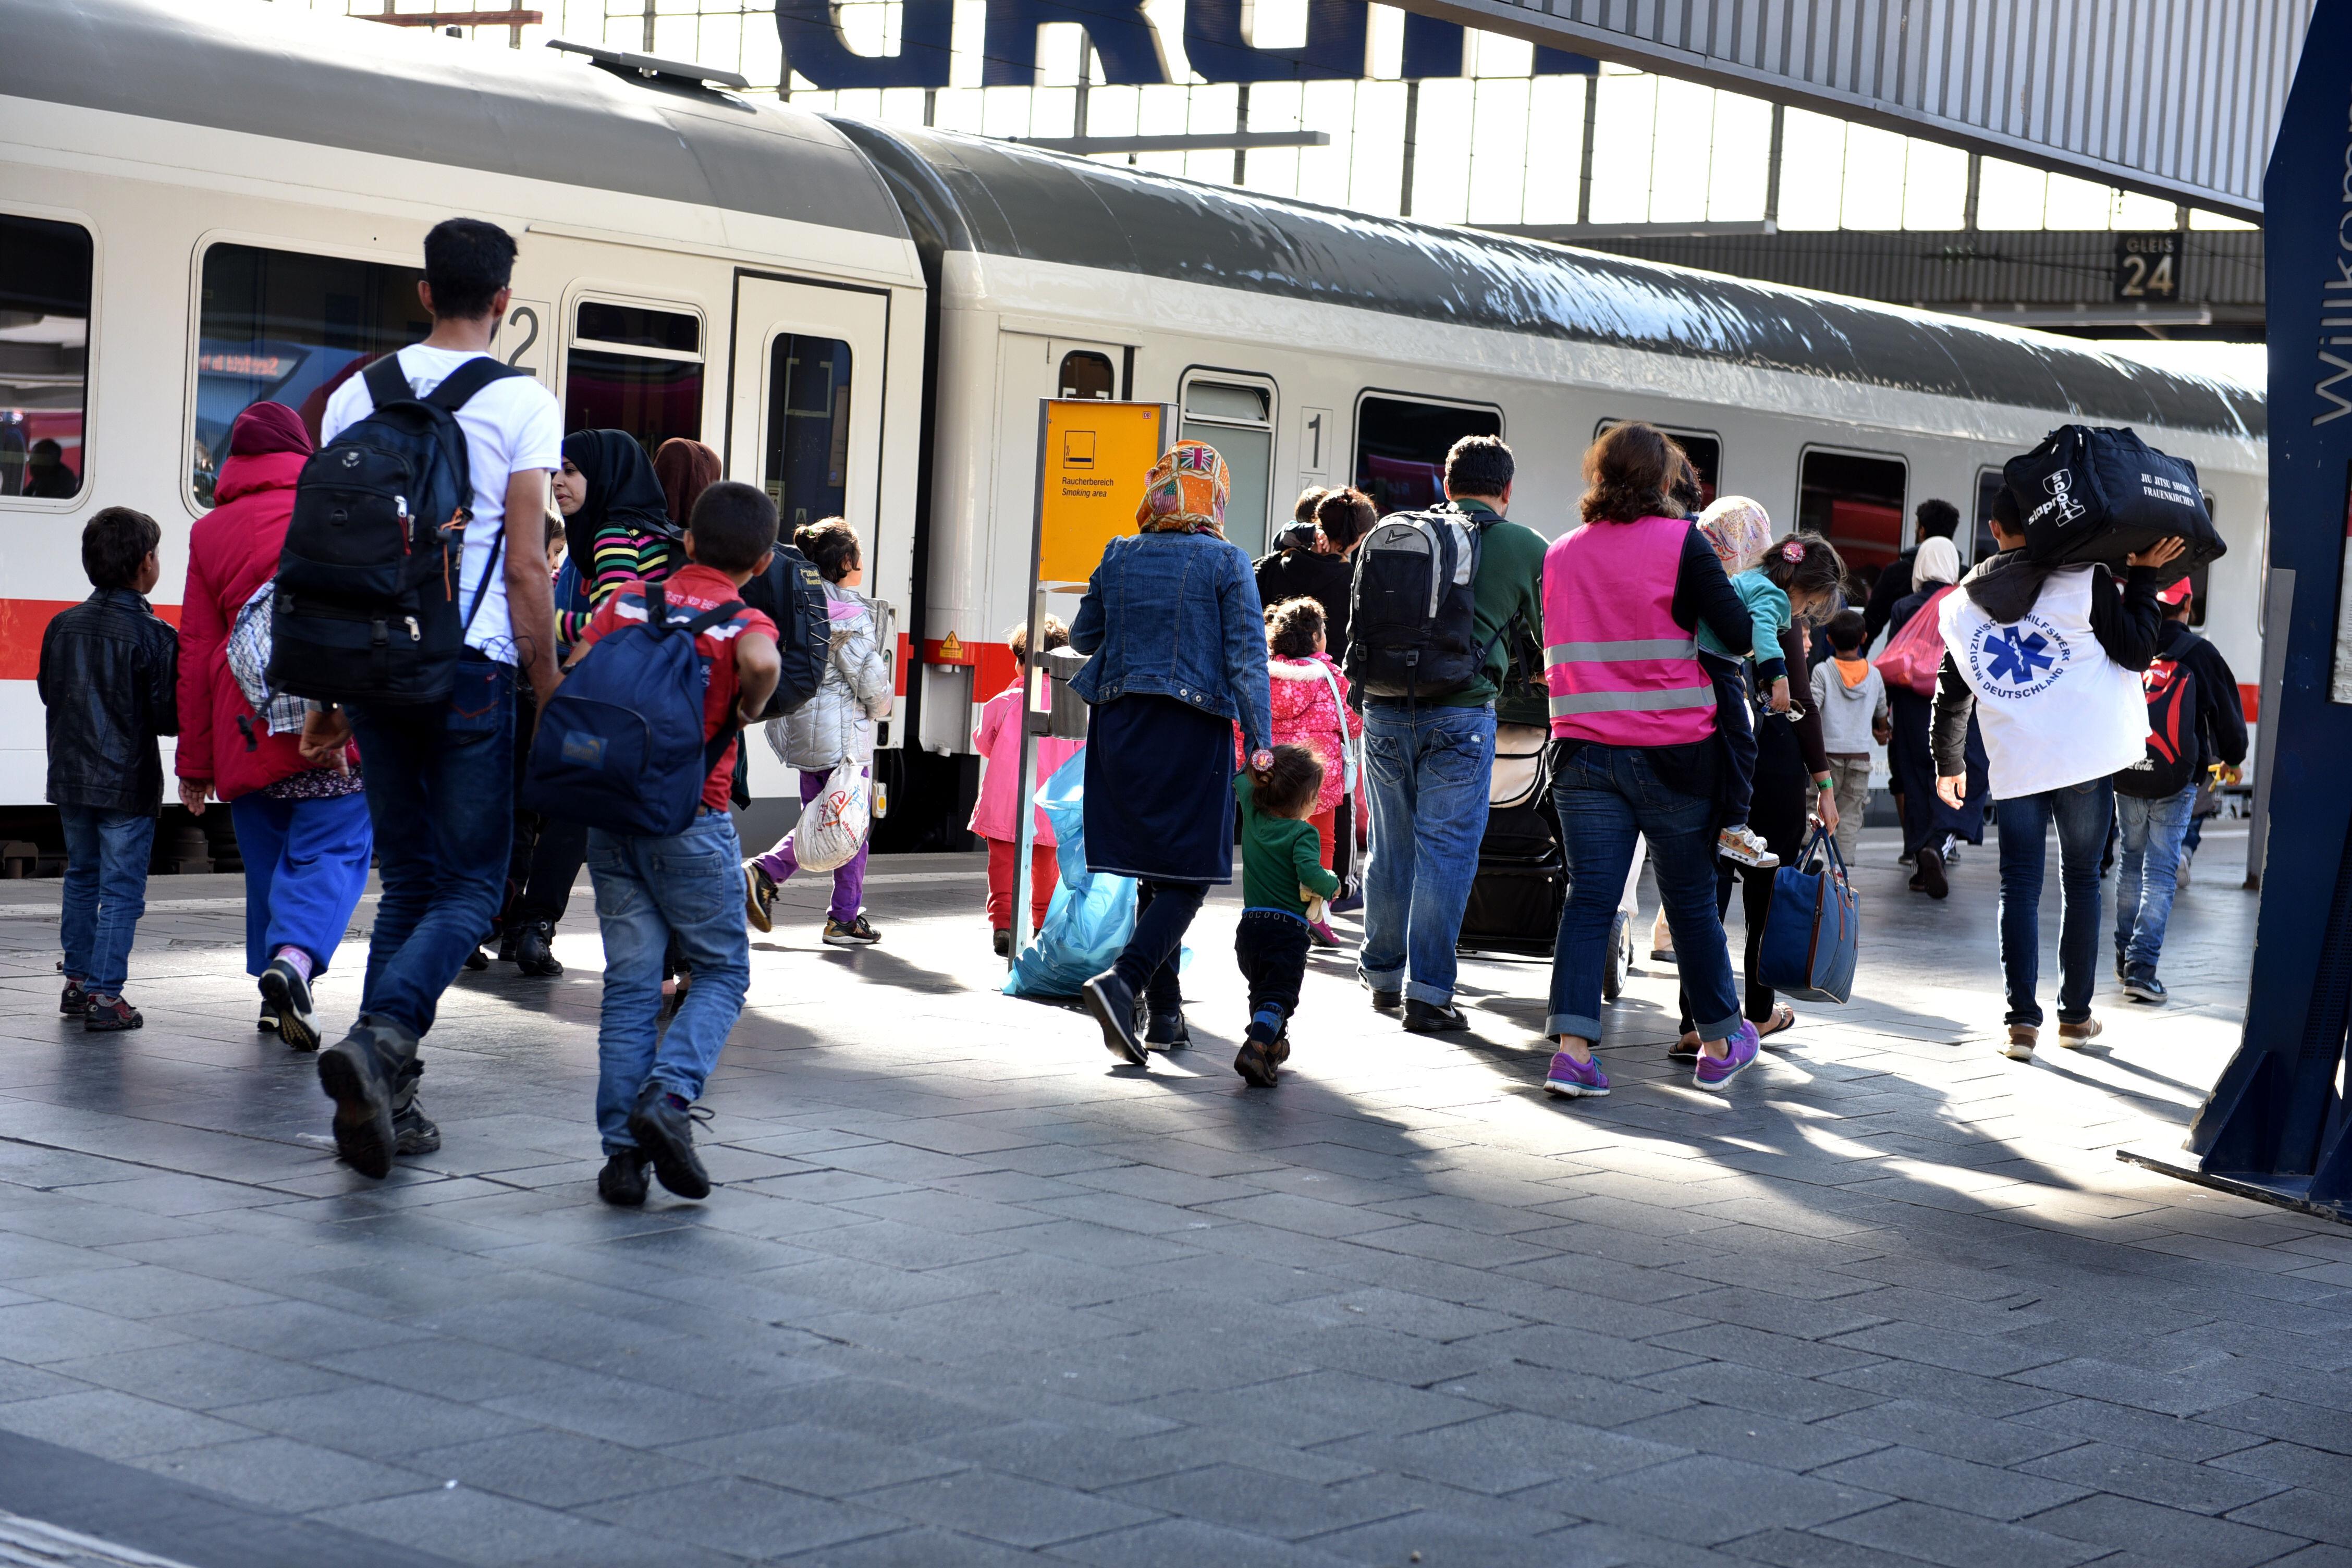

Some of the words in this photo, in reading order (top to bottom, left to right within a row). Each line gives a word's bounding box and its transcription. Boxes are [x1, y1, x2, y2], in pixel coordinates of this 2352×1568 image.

[2127, 237, 2174, 253] GLEIS
[2121, 254, 2174, 297] 24
[507, 307, 538, 377] 2
[1308, 413, 1321, 468] 1
[1062, 477, 1113, 486] Raucherbereich
[2141, 473, 2152, 484] JIU
[2154, 476, 2171, 488] JITSU
[2172, 481, 2191, 495] SHOBU
[1062, 488, 1090, 498] Smoking
[2143, 486, 2195, 508] FRAUENKIRCHEN
[665, 590, 684, 605] RST
[1970, 618, 1998, 681] MEDIZINISC
[701, 678, 710, 687] S
[1982, 667, 2064, 699] DEUTSCHLAND
[2132, 758, 2154, 771] Cola
